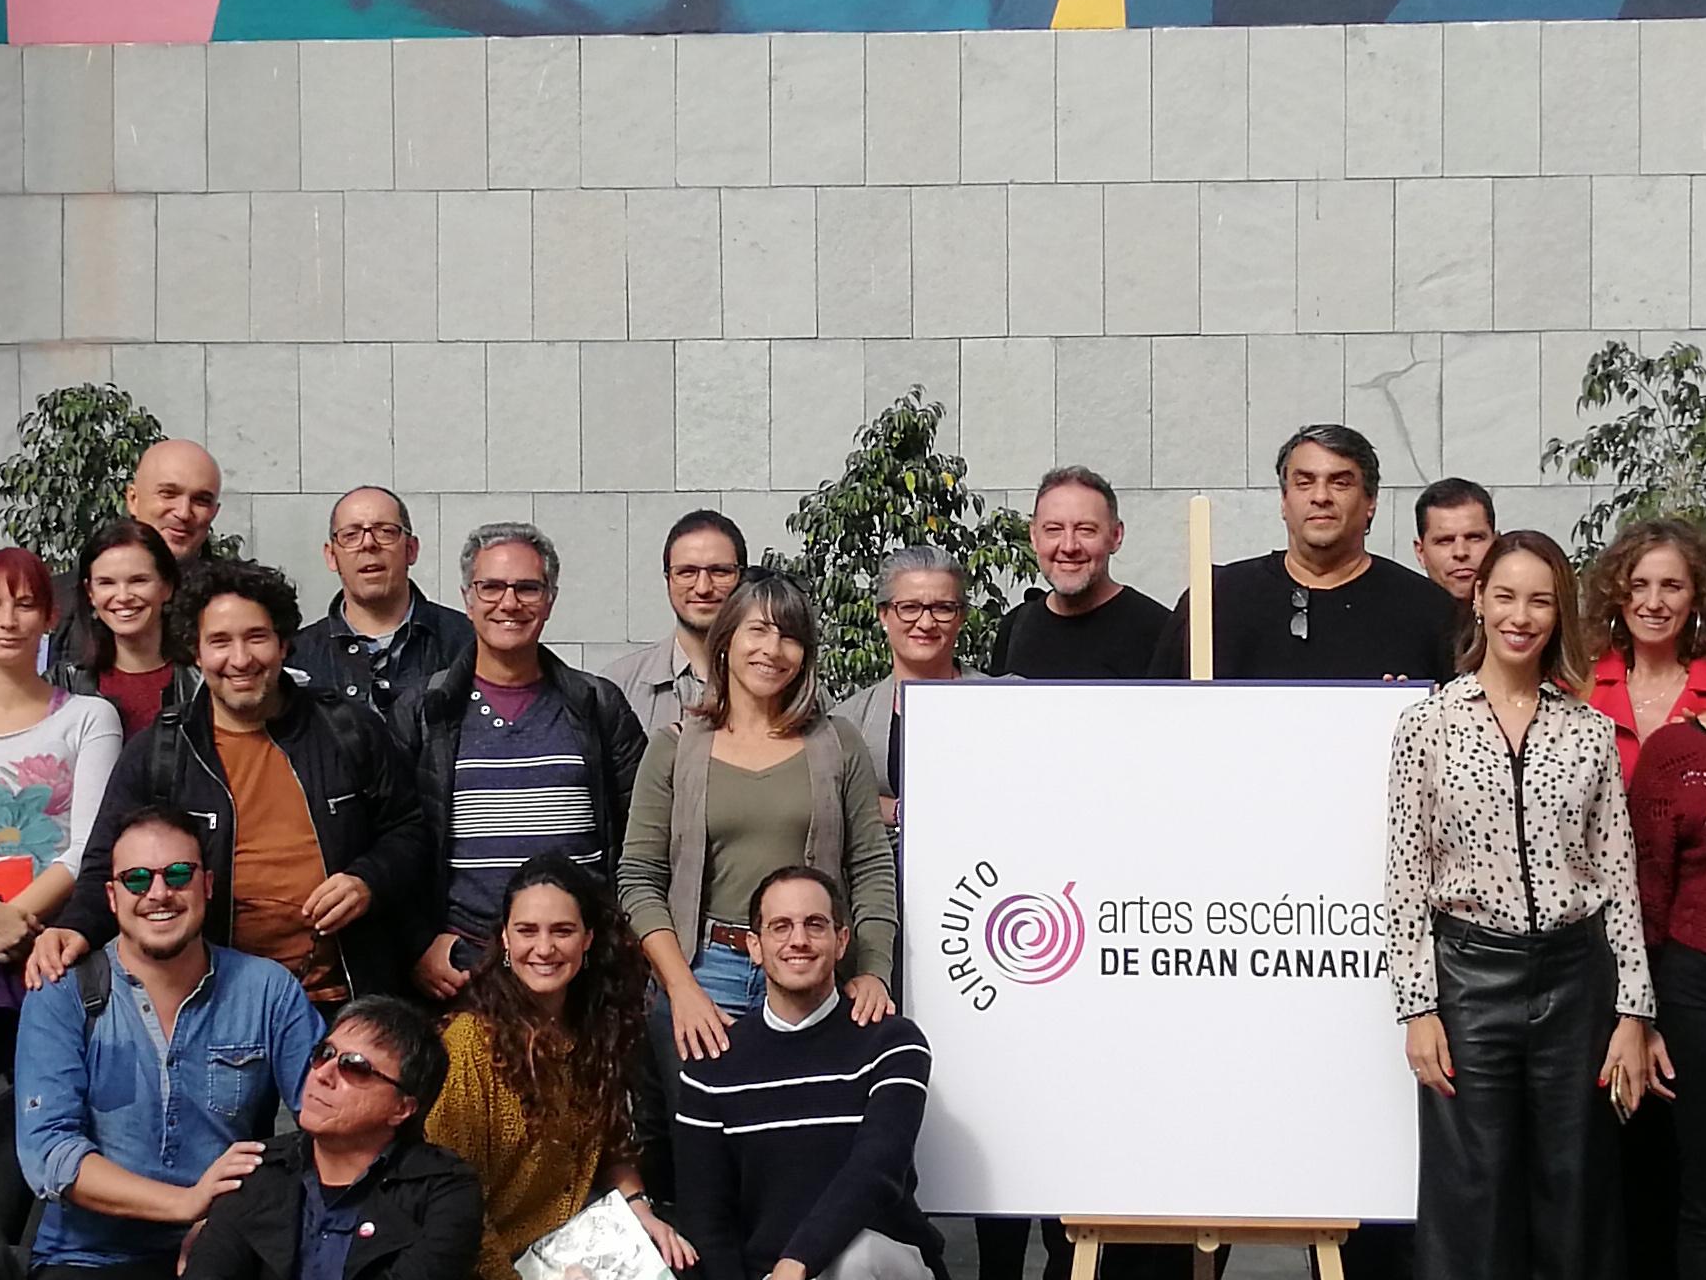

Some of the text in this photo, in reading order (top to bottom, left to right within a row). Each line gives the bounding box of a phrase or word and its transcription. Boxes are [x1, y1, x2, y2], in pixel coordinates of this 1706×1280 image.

[1098, 895, 1192, 935] artes
[941, 861, 999, 1011] CIRCUITO
[1100, 947, 1390, 979] DE GRAN CANARIA
